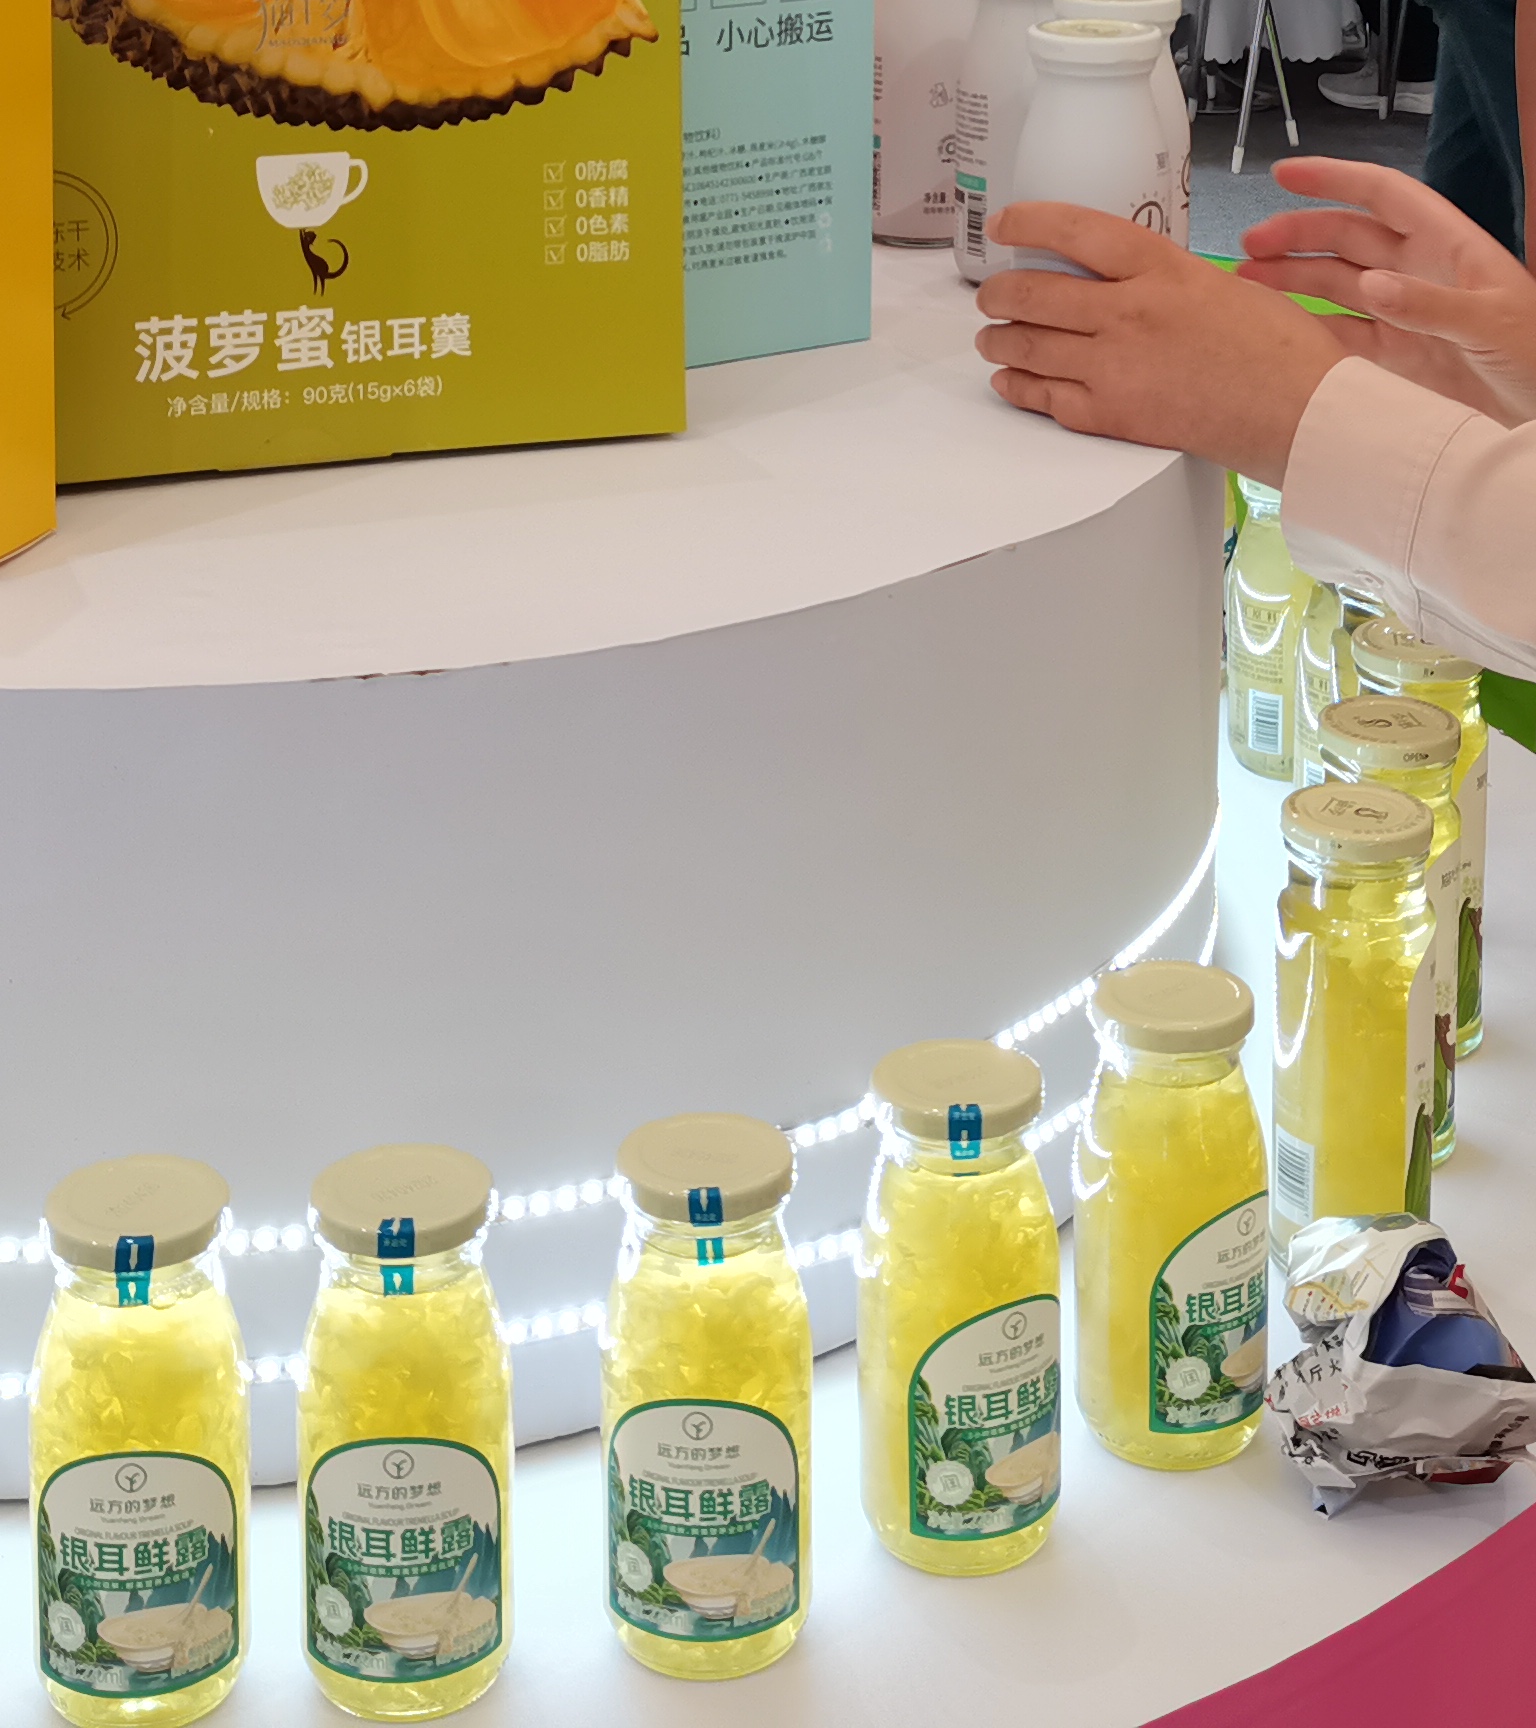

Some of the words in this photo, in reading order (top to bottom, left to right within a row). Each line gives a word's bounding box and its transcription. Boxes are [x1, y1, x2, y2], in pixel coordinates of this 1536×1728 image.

[716, 10, 834, 53] 小心搬运
[657, 1442, 741, 1461] 远方的梦想
[89, 1493, 175, 1515] 远方的梦想
[357, 1480, 442, 1501] 远方的梦想
[629, 1473, 773, 1522] 银耳鲜露
[60, 1524, 210, 1578] 银耳鲜露
[328, 1513, 474, 1563] 银耳鲜露
